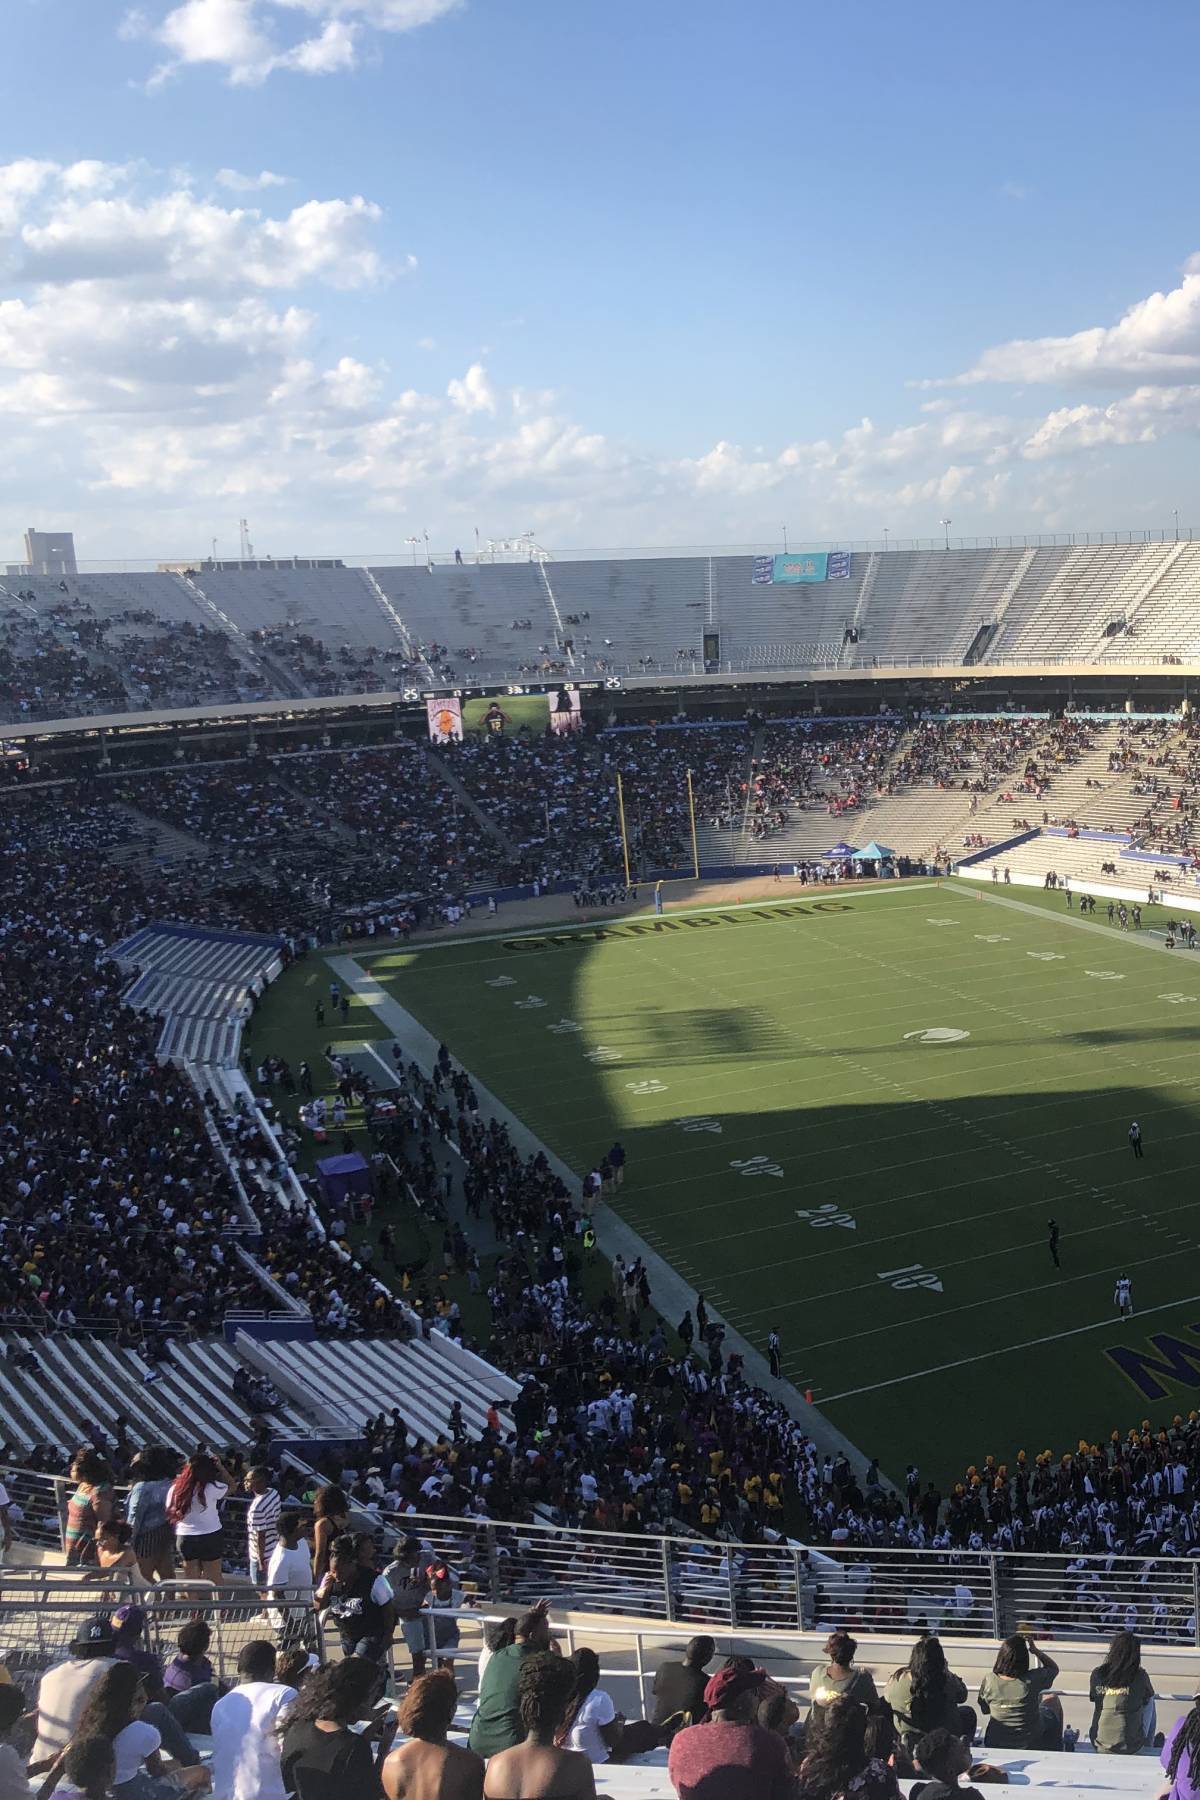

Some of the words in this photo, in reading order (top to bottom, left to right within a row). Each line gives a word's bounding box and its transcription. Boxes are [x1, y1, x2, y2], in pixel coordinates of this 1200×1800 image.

[606, 677, 621, 688] 25
[404, 689, 418, 700] 25
[502, 901, 855, 951] GRAMBLING
[625, 1079, 669, 1095] 50
[674, 1116, 720, 1132] 40
[729, 1155, 781, 1176] 30
[795, 1203, 853, 1228] 20
[877, 1263, 938, 1289] 10
